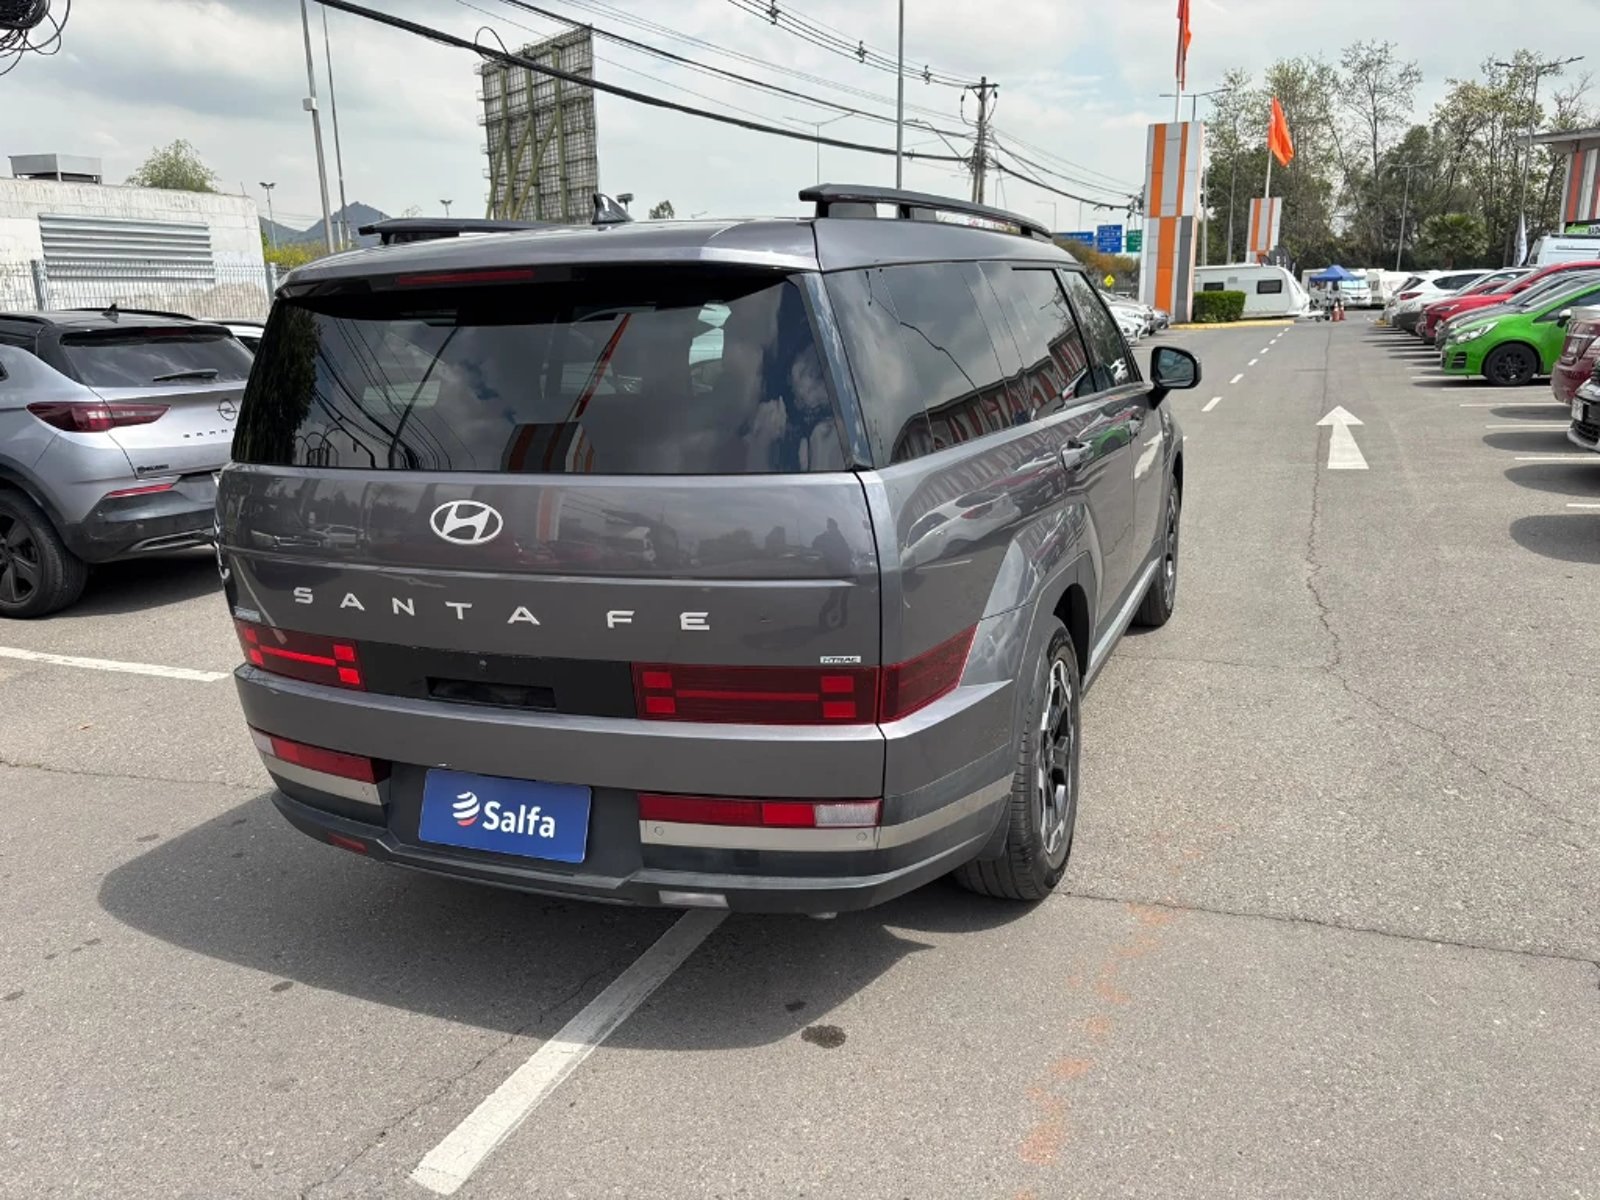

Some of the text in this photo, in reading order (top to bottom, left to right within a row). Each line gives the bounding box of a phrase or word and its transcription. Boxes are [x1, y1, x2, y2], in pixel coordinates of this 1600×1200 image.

[293, 586, 541, 626] SANTA
[606, 609, 711, 631] FE
[482, 800, 556, 838] Salfa
